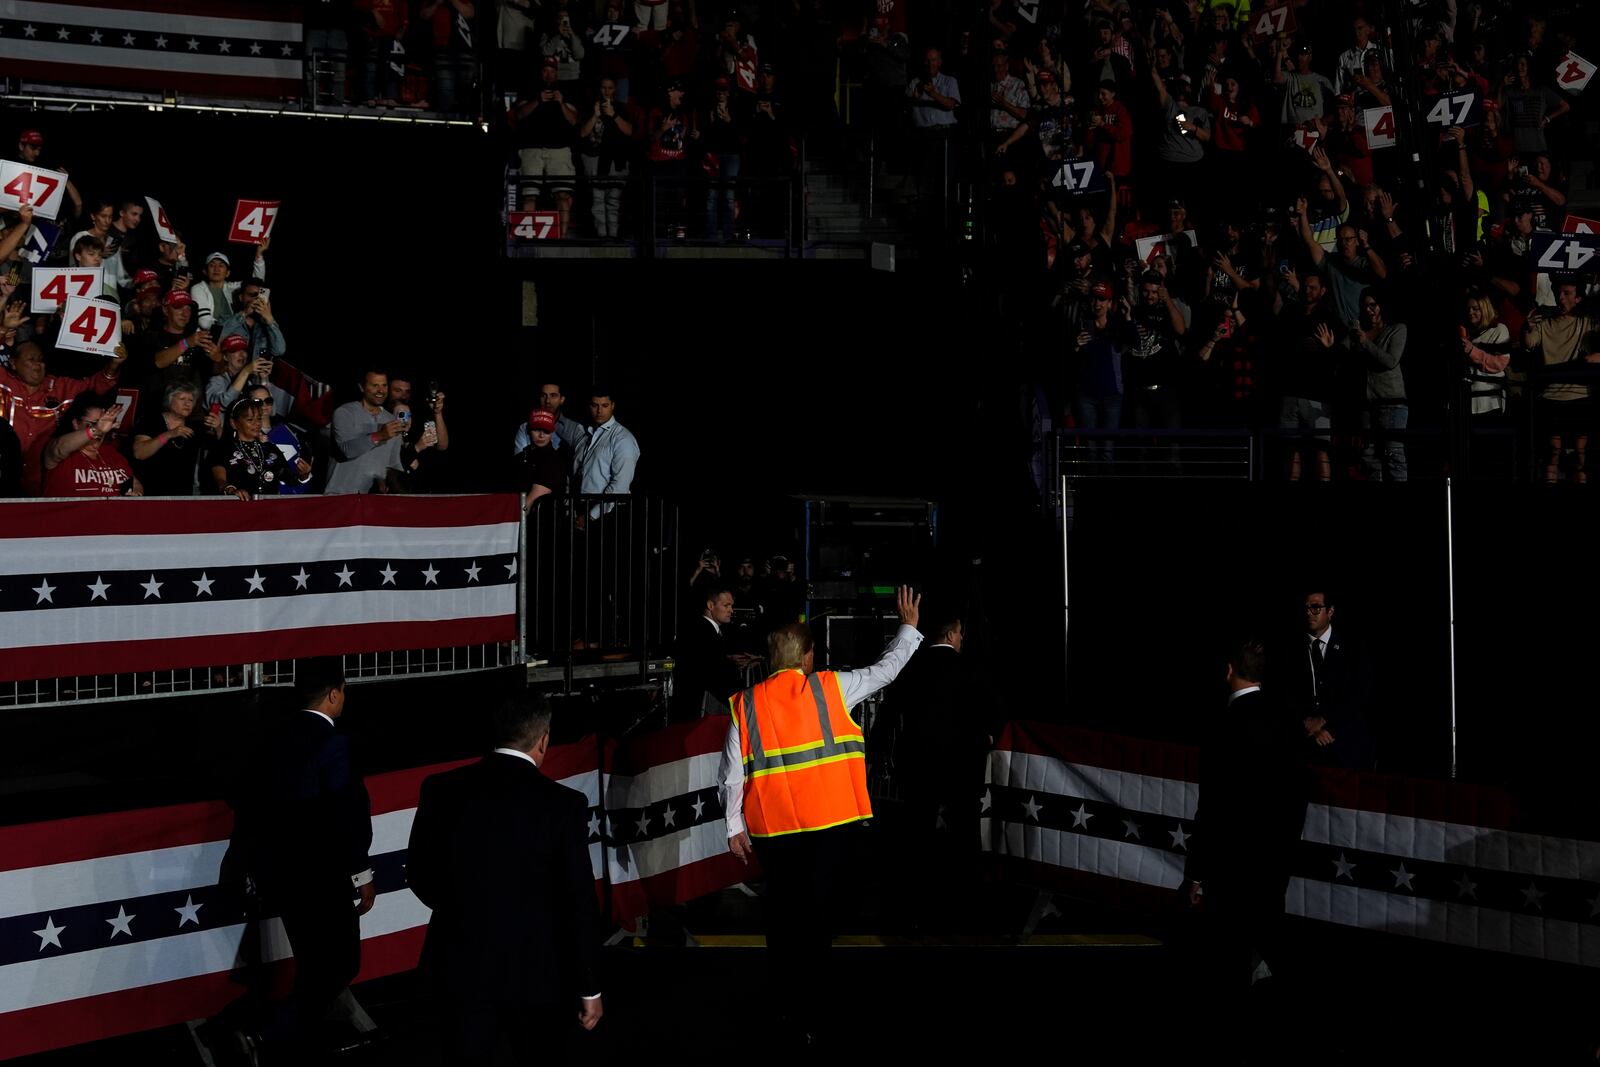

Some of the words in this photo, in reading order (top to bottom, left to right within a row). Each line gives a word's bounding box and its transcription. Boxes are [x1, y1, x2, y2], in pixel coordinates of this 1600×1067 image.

[593, 24, 631, 46] 47
[1256, 7, 1288, 35] 47
[389, 39, 406, 77] 47
[1426, 92, 1475, 126] 47
[4, 172, 59, 207] 47
[1052, 161, 1094, 190] 47
[238, 207, 279, 238] 47
[514, 216, 554, 239] 47
[1538, 239, 1596, 269] 47
[40, 275, 94, 306] 47
[70, 306, 116, 345] 47
[75, 467, 129, 486] NATIVES
